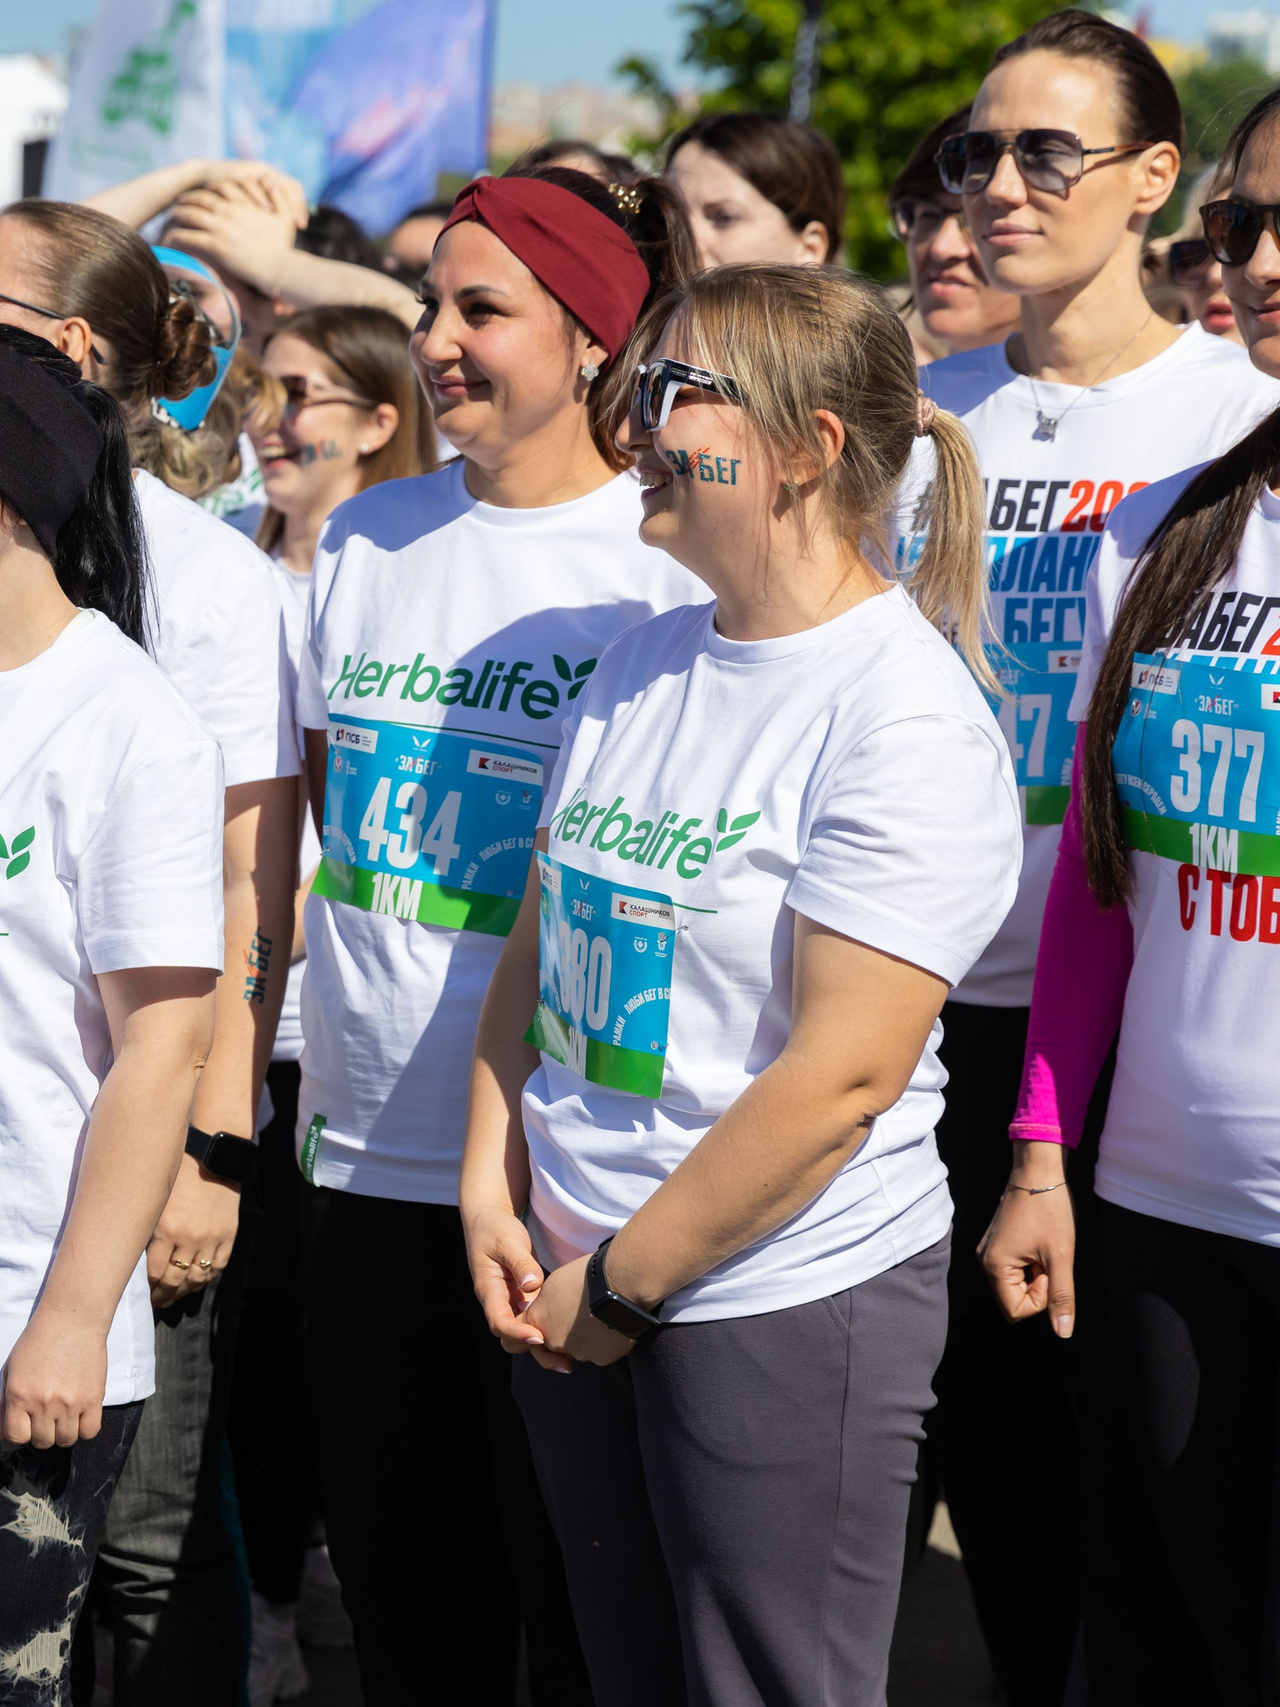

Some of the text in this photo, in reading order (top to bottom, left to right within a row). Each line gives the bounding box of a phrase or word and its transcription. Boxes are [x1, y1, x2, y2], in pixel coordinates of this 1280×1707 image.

[327, 652, 560, 720] Herbalife
[345, 731, 361, 744] ПСБ
[492, 765, 514, 774] СПОРТ
[493, 760, 537, 774] КАЛАШНИКОВ
[1170, 718, 1265, 823] 377
[358, 776, 463, 877] 434
[550, 787, 713, 880] Herbalife
[502, 837, 516, 850] БЕГ
[1177, 863, 1200, 931] С
[630, 904, 670, 917] КАЛАШНИКОВ
[630, 910, 648, 918] СПОРТ
[558, 920, 612, 1031] 380
[643, 987, 657, 1001] БЕГ
